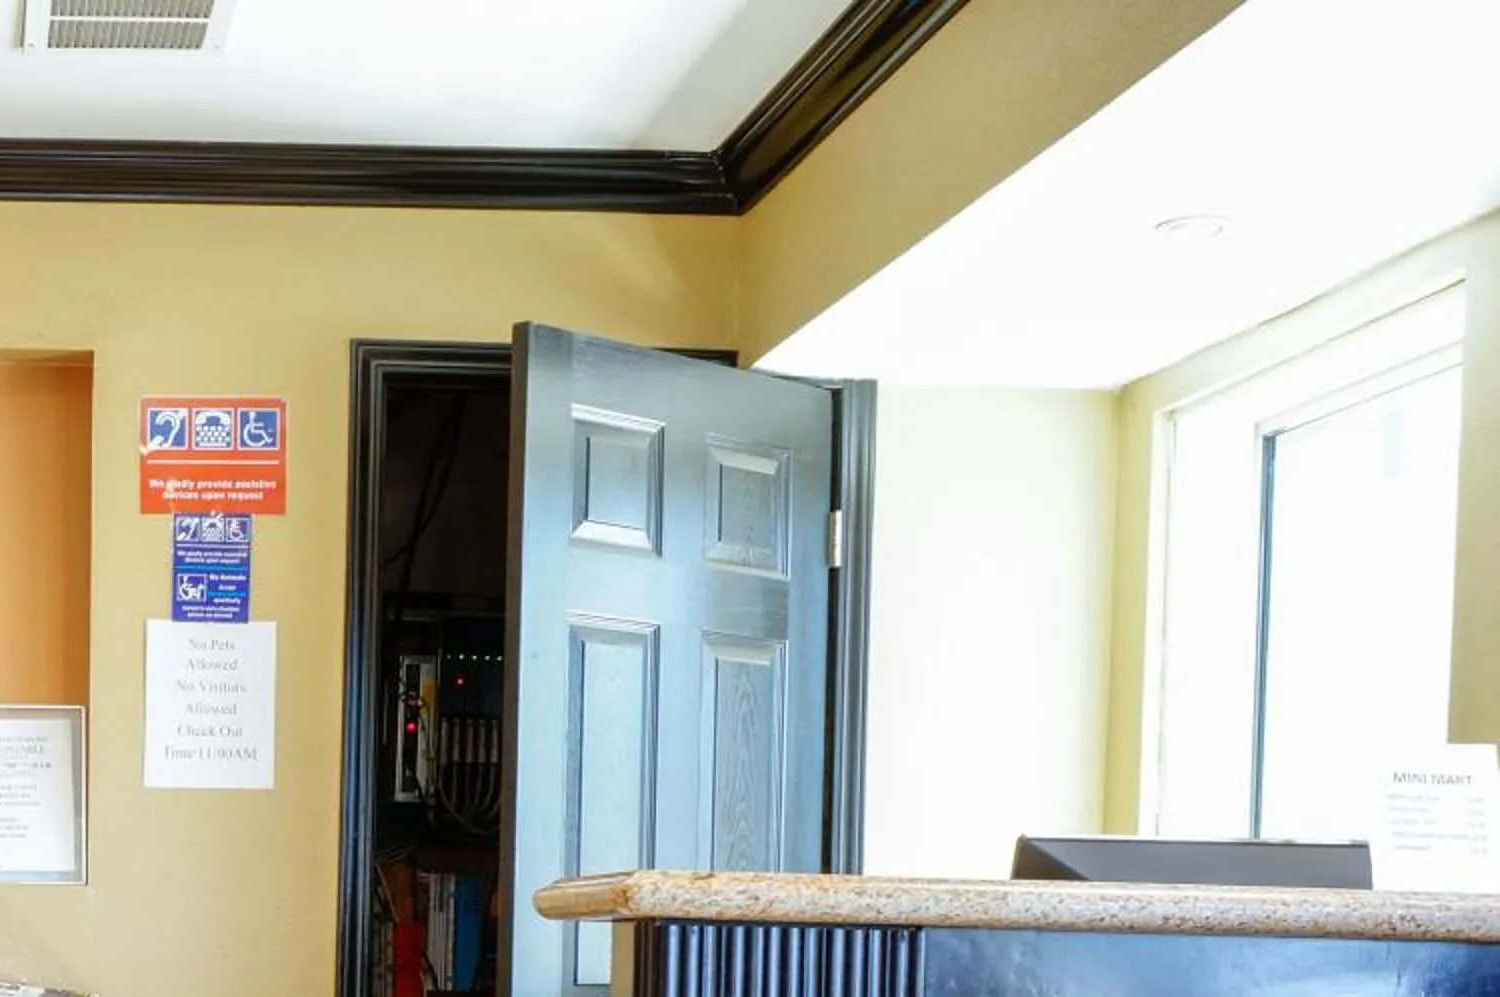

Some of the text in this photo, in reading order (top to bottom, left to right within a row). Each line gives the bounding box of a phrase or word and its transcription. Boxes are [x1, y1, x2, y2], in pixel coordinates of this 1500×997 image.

[148, 479, 164, 489] We
[197, 479, 233, 490] provide
[201, 492, 225, 502] upon
[228, 492, 263, 502] request
[188, 638, 236, 651] No Pets
[187, 658, 238, 671] Allowed
[176, 679, 247, 693] No Visitors
[185, 703, 238, 716] Allowed
[177, 725, 243, 738] Check Out
[164, 746, 194, 759] Time
[1393, 771, 1472, 785] MINI MART
